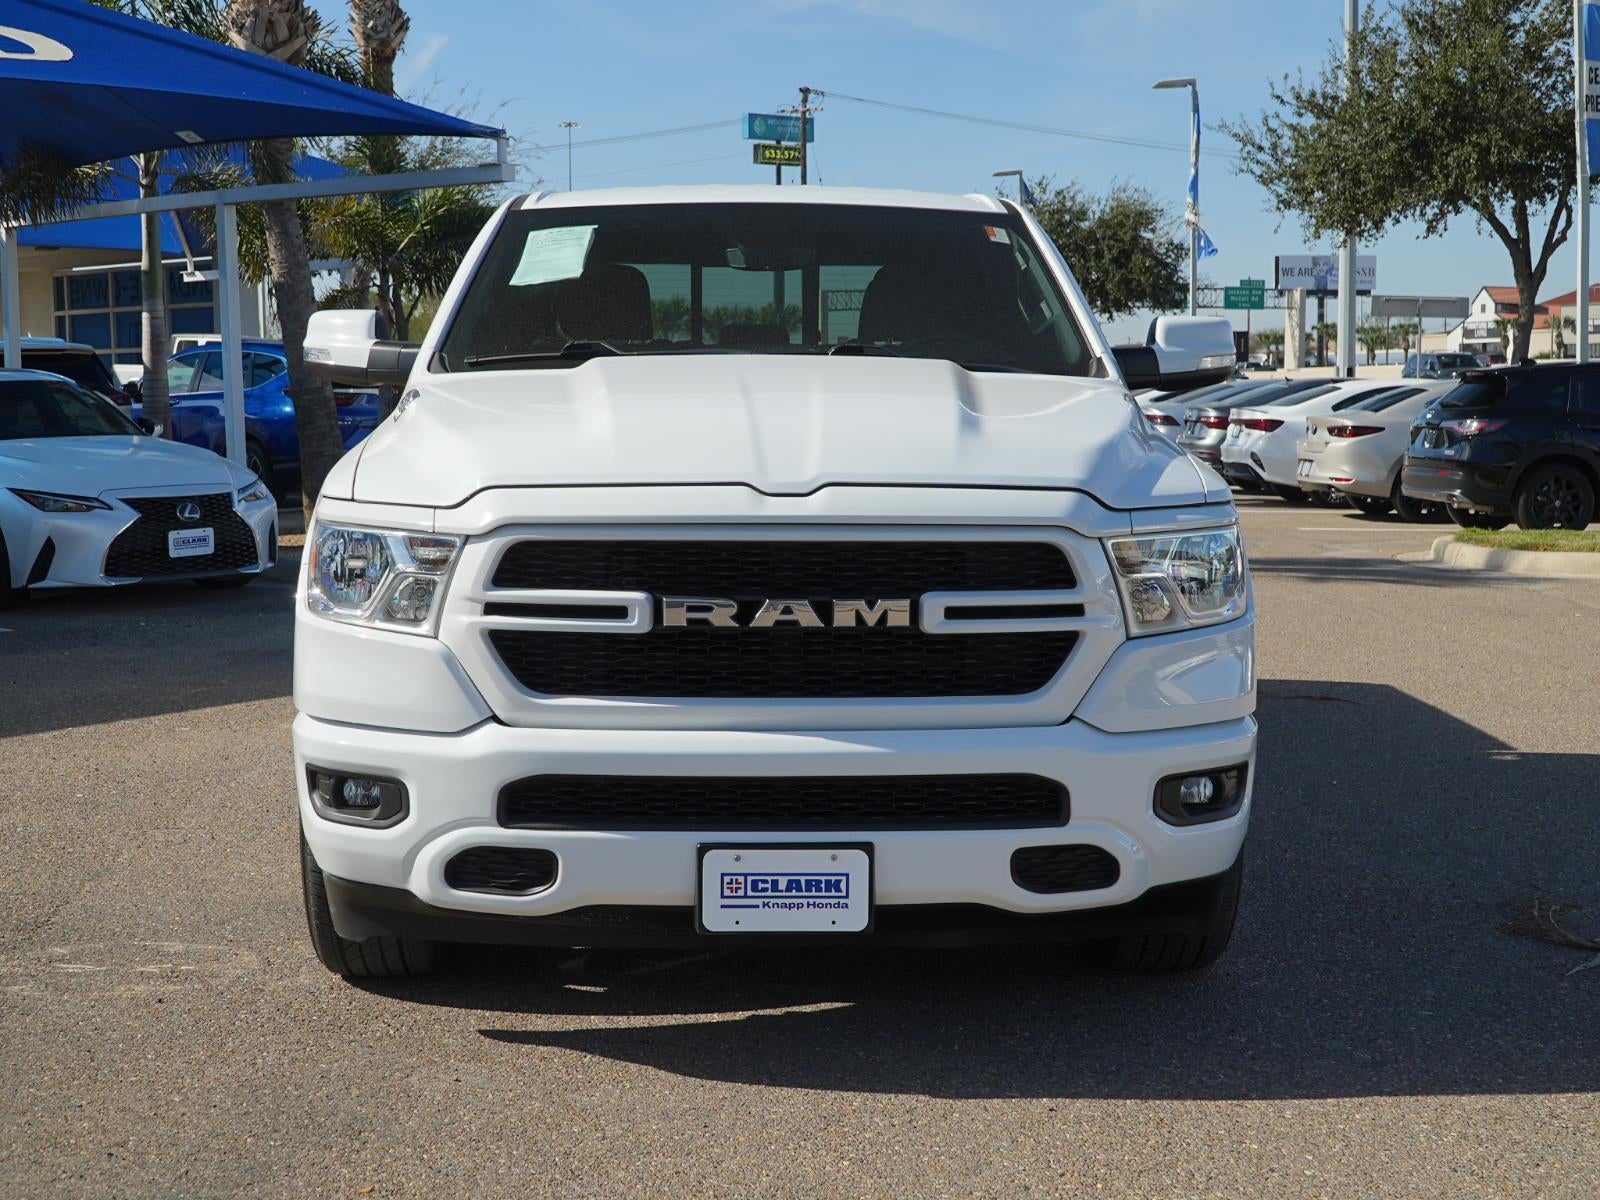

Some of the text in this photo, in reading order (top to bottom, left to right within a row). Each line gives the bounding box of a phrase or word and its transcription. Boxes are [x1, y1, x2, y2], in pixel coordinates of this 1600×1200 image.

[1281, 267, 1315, 277] WE ARE
[182, 537, 208, 545] CLARK
[663, 596, 910, 627] RAM
[750, 878, 843, 893] CLARK
[761, 901, 849, 911] Knapp Honda
